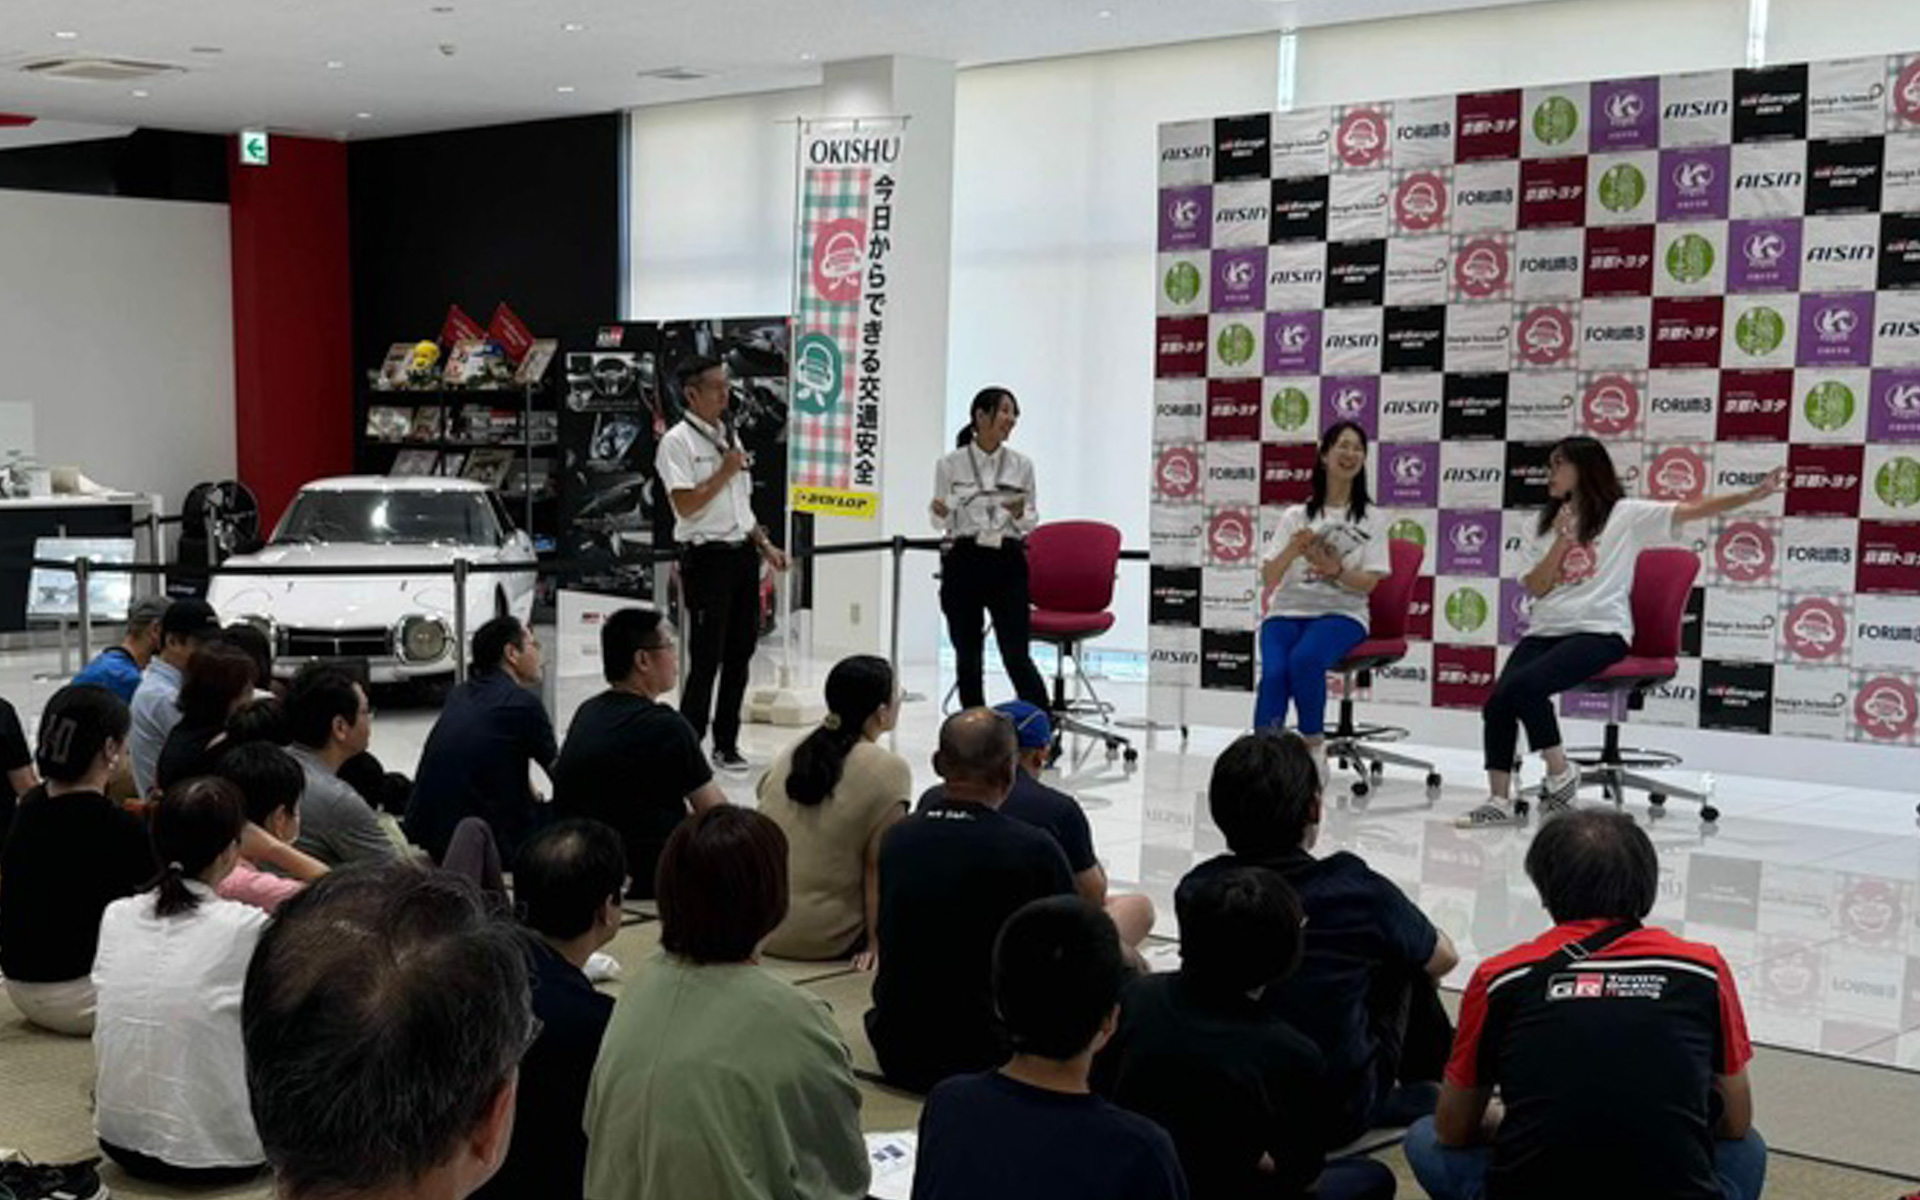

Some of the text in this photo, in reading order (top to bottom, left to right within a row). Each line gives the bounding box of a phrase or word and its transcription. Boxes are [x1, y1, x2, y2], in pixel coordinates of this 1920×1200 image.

[1664, 99, 1728, 120] AISIN
[810, 137, 900, 164] OKISHU
[1162, 145, 1211, 163] AISIN
[1735, 171, 1801, 190] AISIN
[1215, 206, 1269, 224] AISIN
[1807, 244, 1875, 263] AISIN
[1270, 269, 1322, 286] AISIN
[855, 174, 895, 486] 今日からできる交通安全
[1878, 319, 1920, 338] AIS
[1325, 332, 1379, 349] AISIN
[1383, 400, 1440, 415] AISIN
[1442, 466, 1501, 483] AISIN
[807, 492, 868, 510] DUNLOP
